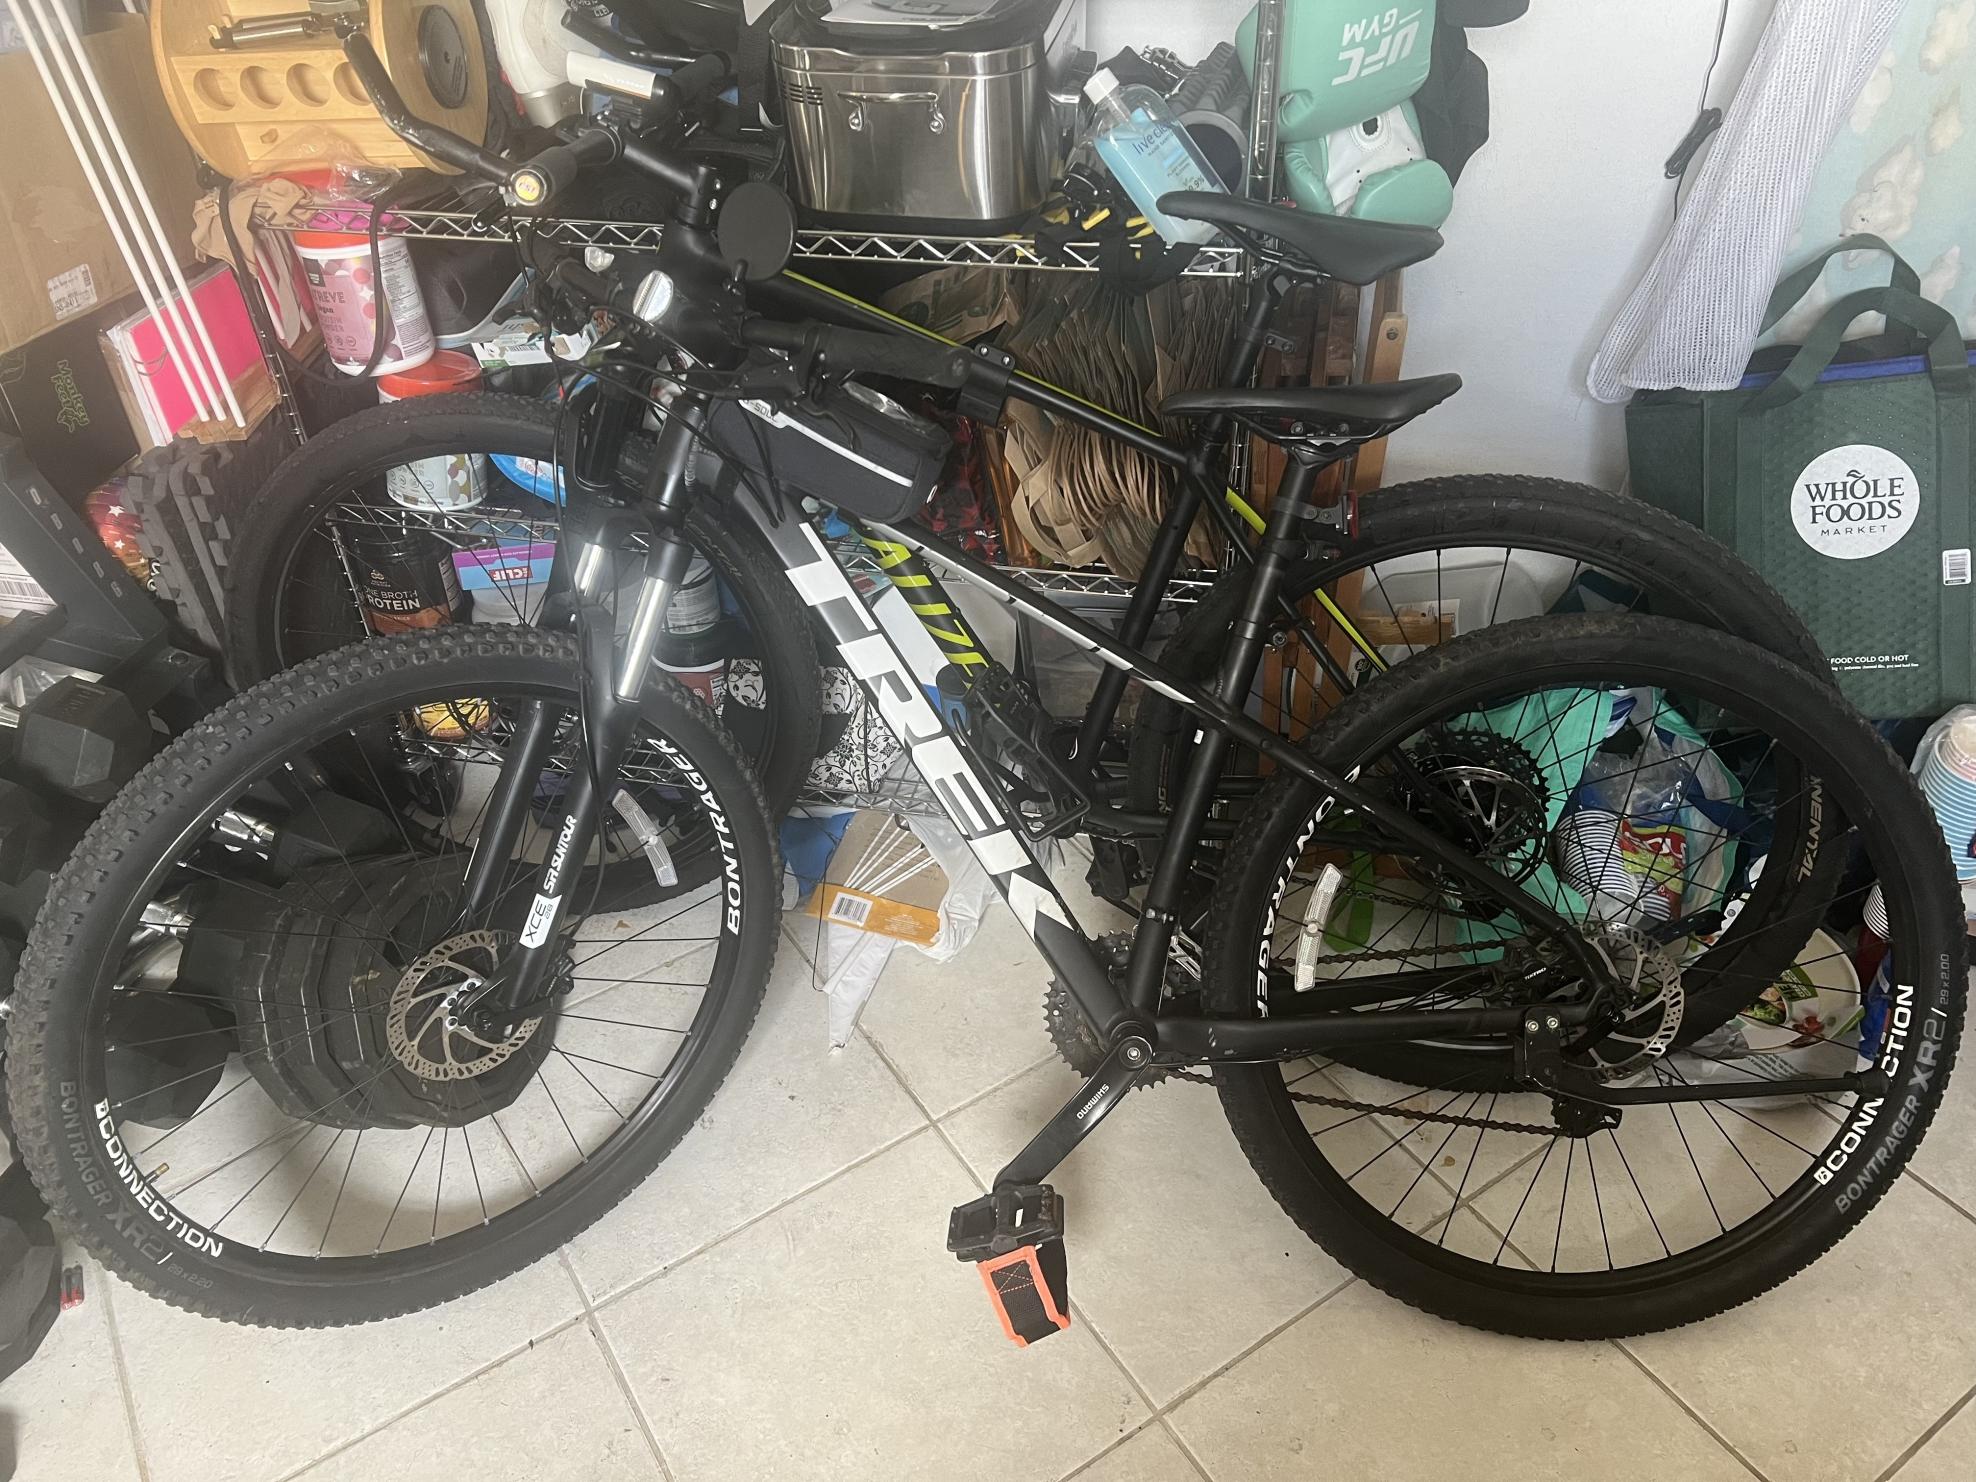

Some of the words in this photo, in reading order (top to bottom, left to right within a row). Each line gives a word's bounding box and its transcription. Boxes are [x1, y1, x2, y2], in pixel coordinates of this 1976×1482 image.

[1341, 7, 1399, 47] GYM
[1331, 20, 1420, 87] UFC
[1132, 134, 1155, 155] live
[1805, 473, 1905, 503] WHOLE
[1810, 499, 1902, 524] FOODS
[1820, 524, 1888, 537] MARKET
[493, 568, 523, 581] CLIF
[1830, 656, 1853, 664] FOOD
[1854, 655, 1877, 663] COLD
[1878, 655, 1890, 663] OR
[1891, 654, 1909, 662] HOT
[785, 522, 1075, 942] TREK
[551, 814, 578, 873] SUNTOUR
[647, 738, 742, 936] BONTRAGER
[543, 867, 560, 894] SR
[525, 899, 547, 943] XCE
[1826, 984, 1914, 1172] CONNCTION
[1076, 1083, 1110, 1120] SHIMANO
[60, 1080, 113, 1207] BONTRAGER
[1834, 1094, 1922, 1215] BONTRAGER
[98, 1115, 224, 1258] CONNECTION
